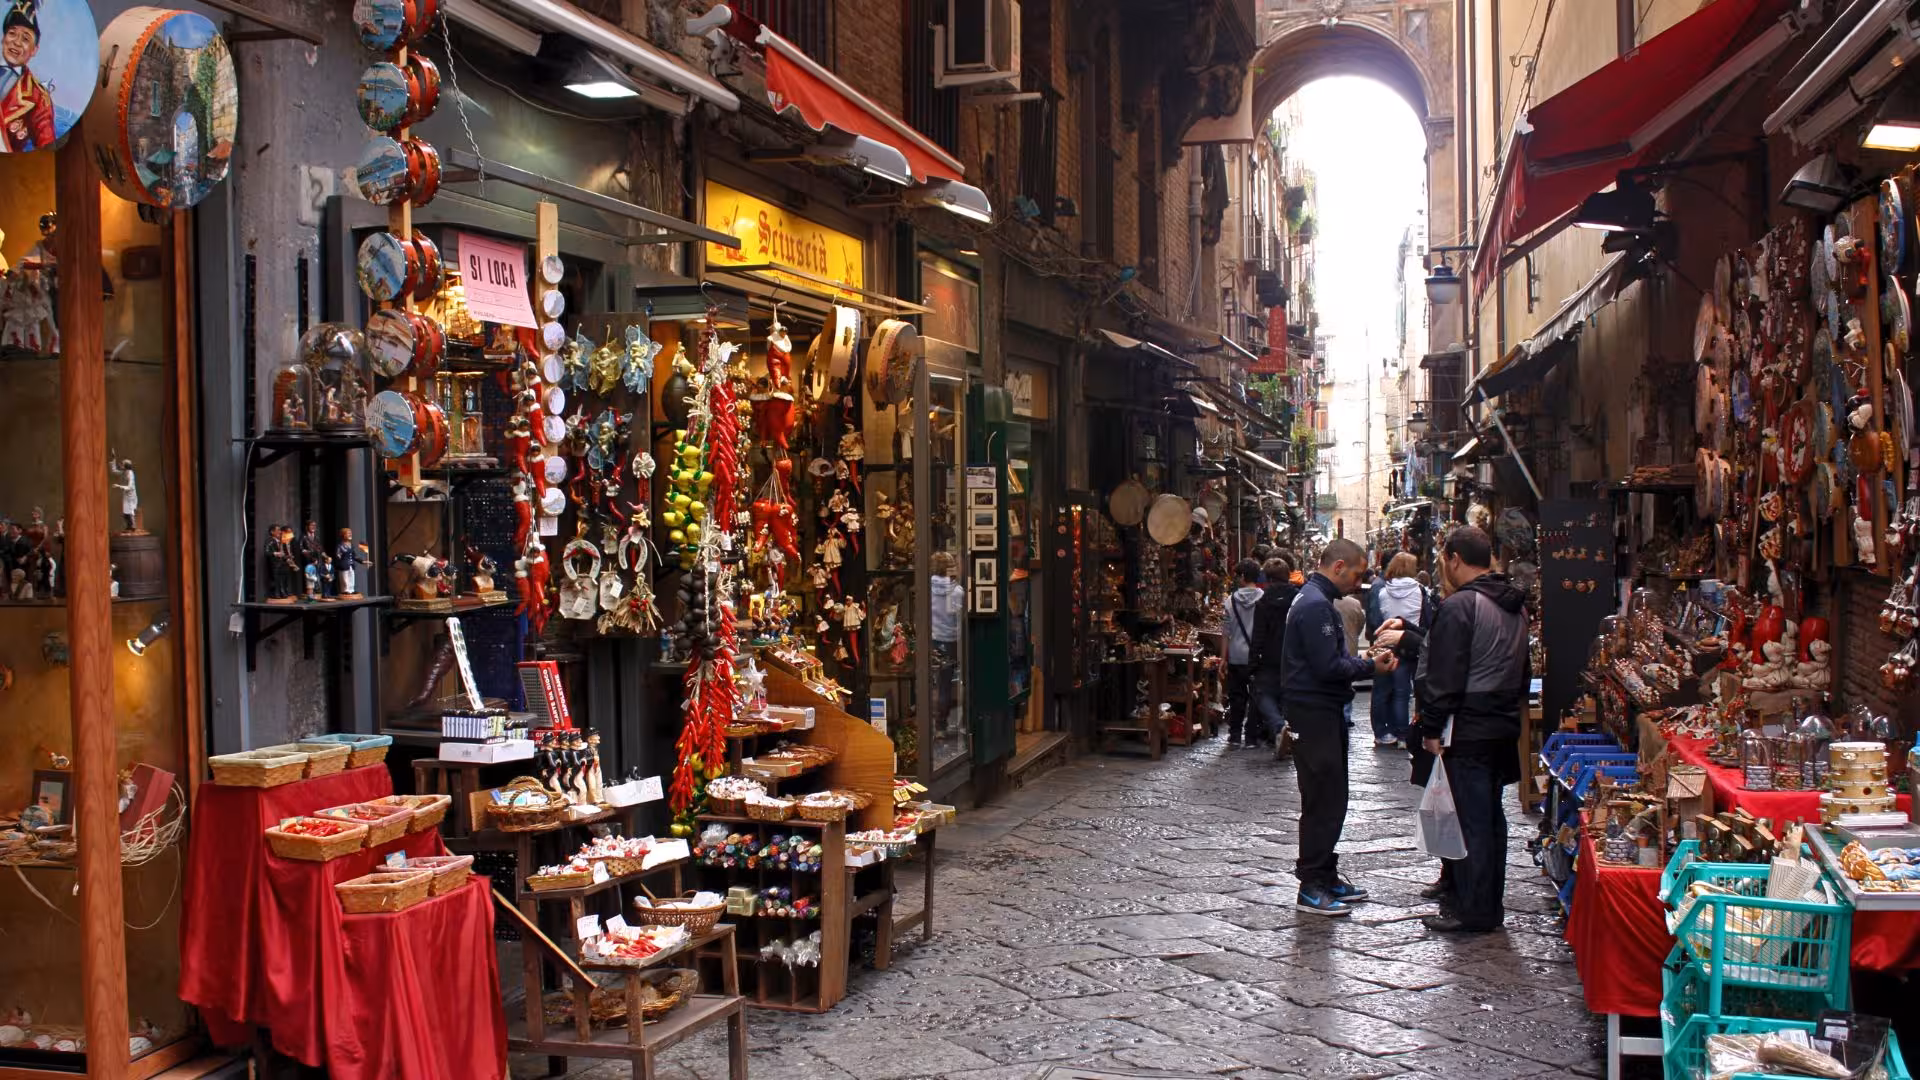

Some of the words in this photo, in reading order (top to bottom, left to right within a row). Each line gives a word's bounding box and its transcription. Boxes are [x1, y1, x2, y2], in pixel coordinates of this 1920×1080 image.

[758, 210, 828, 276] Sciuscià
[470, 254, 482, 282] SI
[488, 258, 517, 289] LOCA
[543, 669, 551, 690] GIOCO
[548, 691, 554, 700] DA
[551, 702, 559, 723] CARTE
